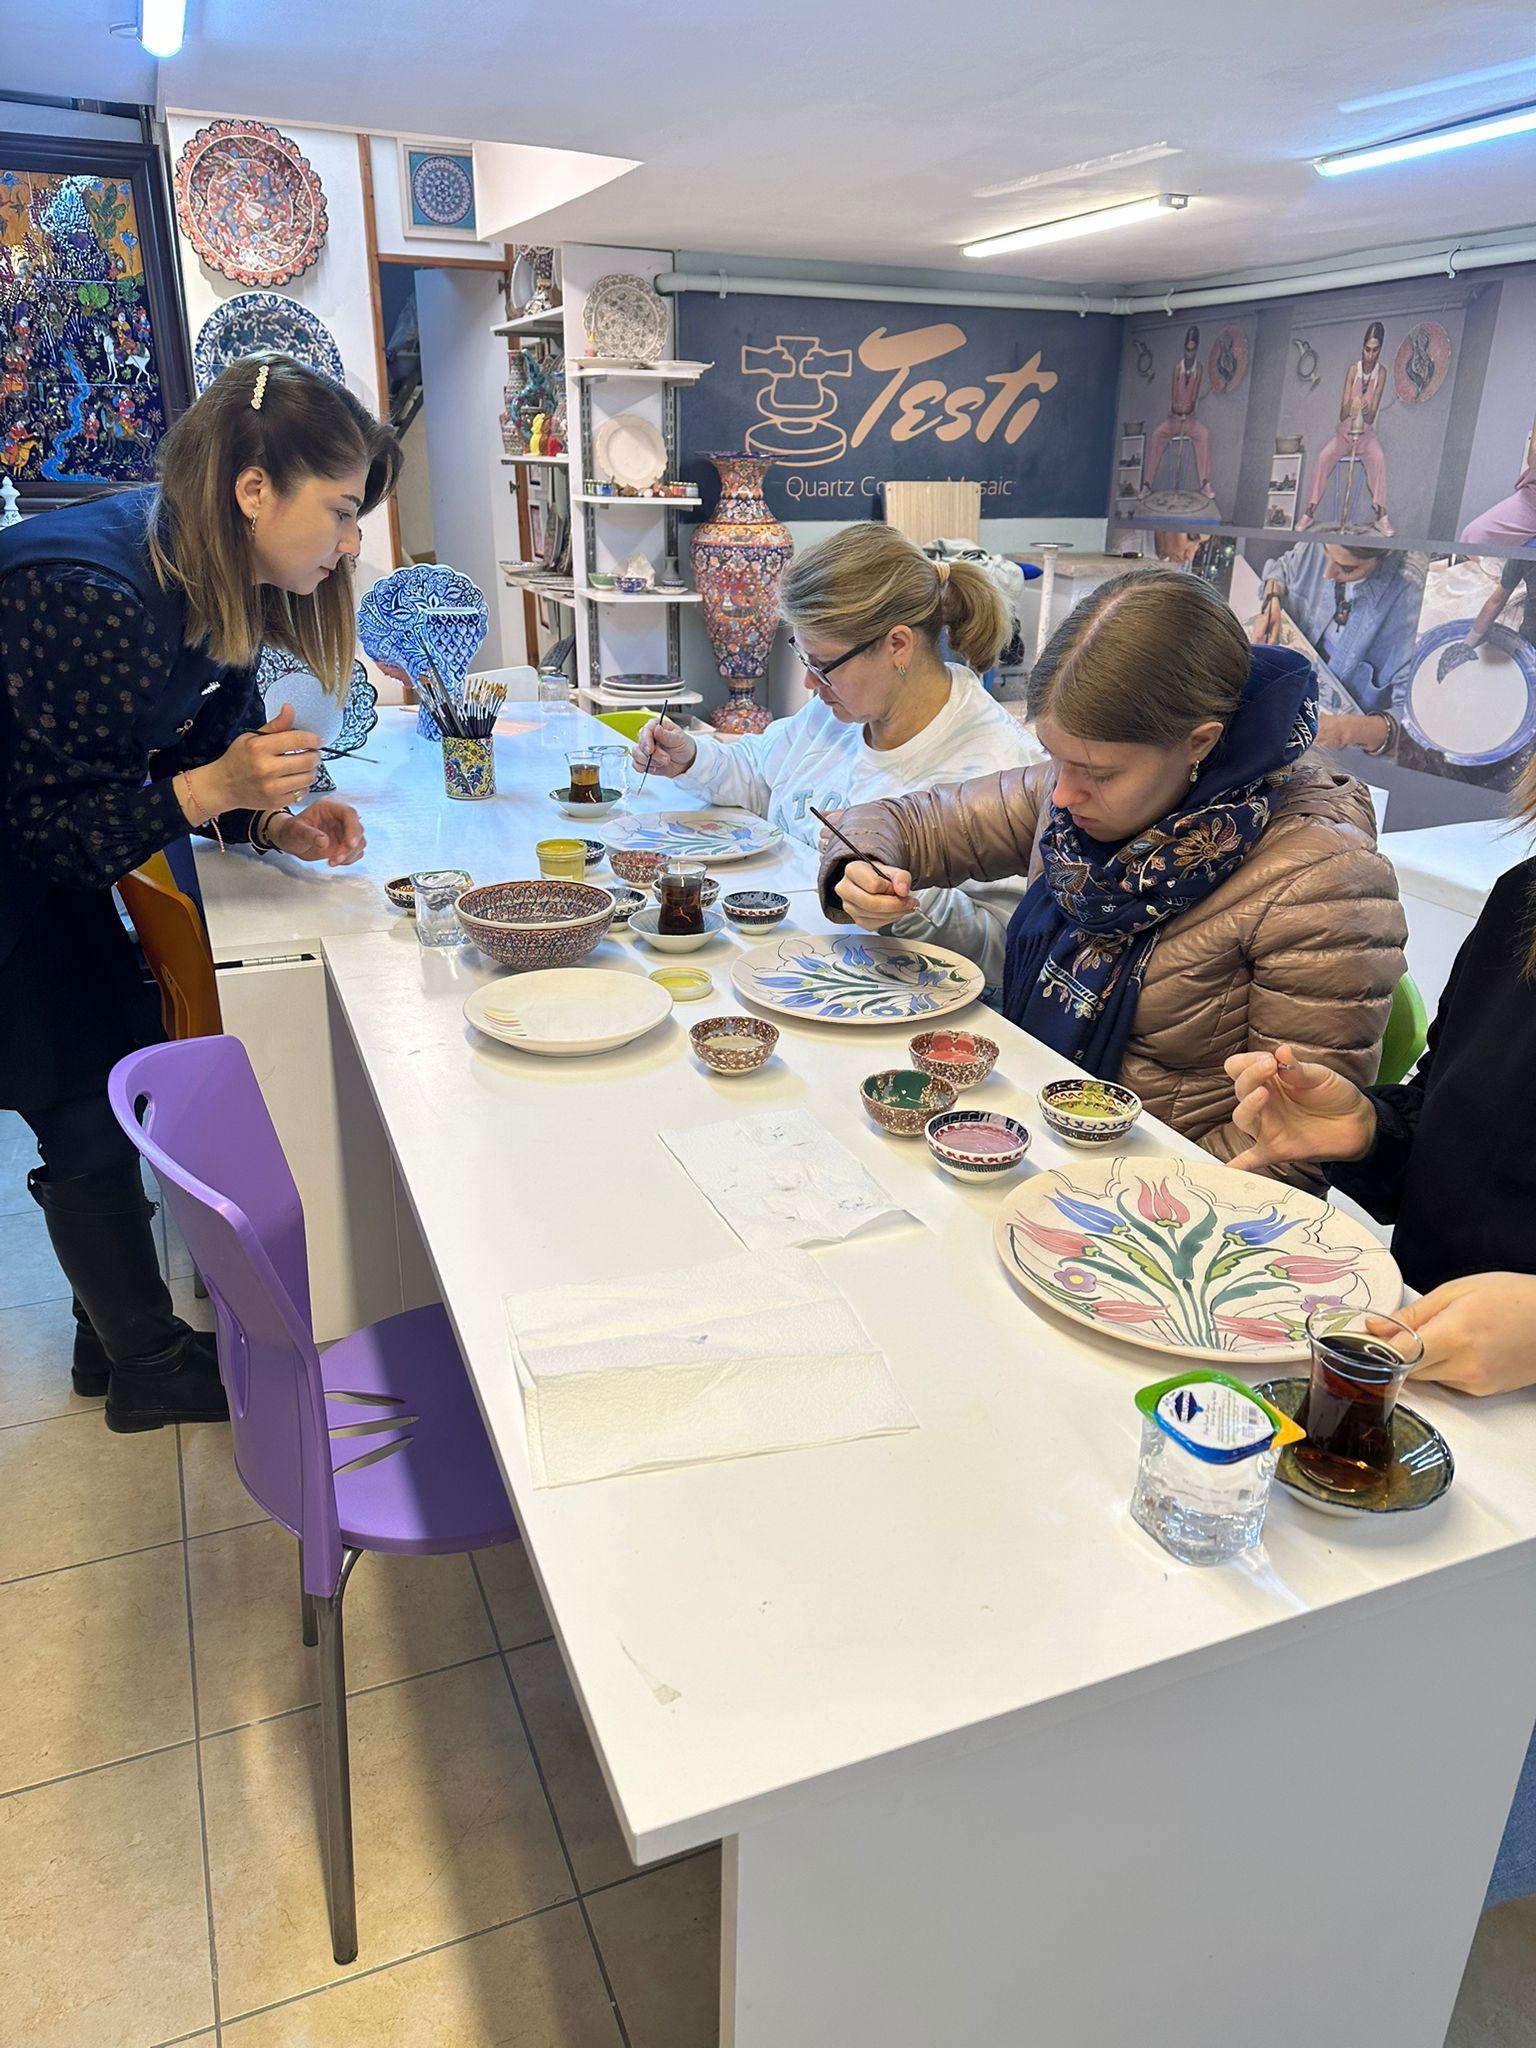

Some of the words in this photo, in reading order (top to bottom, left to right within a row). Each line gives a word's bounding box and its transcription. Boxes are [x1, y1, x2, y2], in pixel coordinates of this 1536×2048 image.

[851, 323, 1058, 448] Testi
[785, 476, 855, 500] Quartz
[947, 475, 1013, 496] saic
